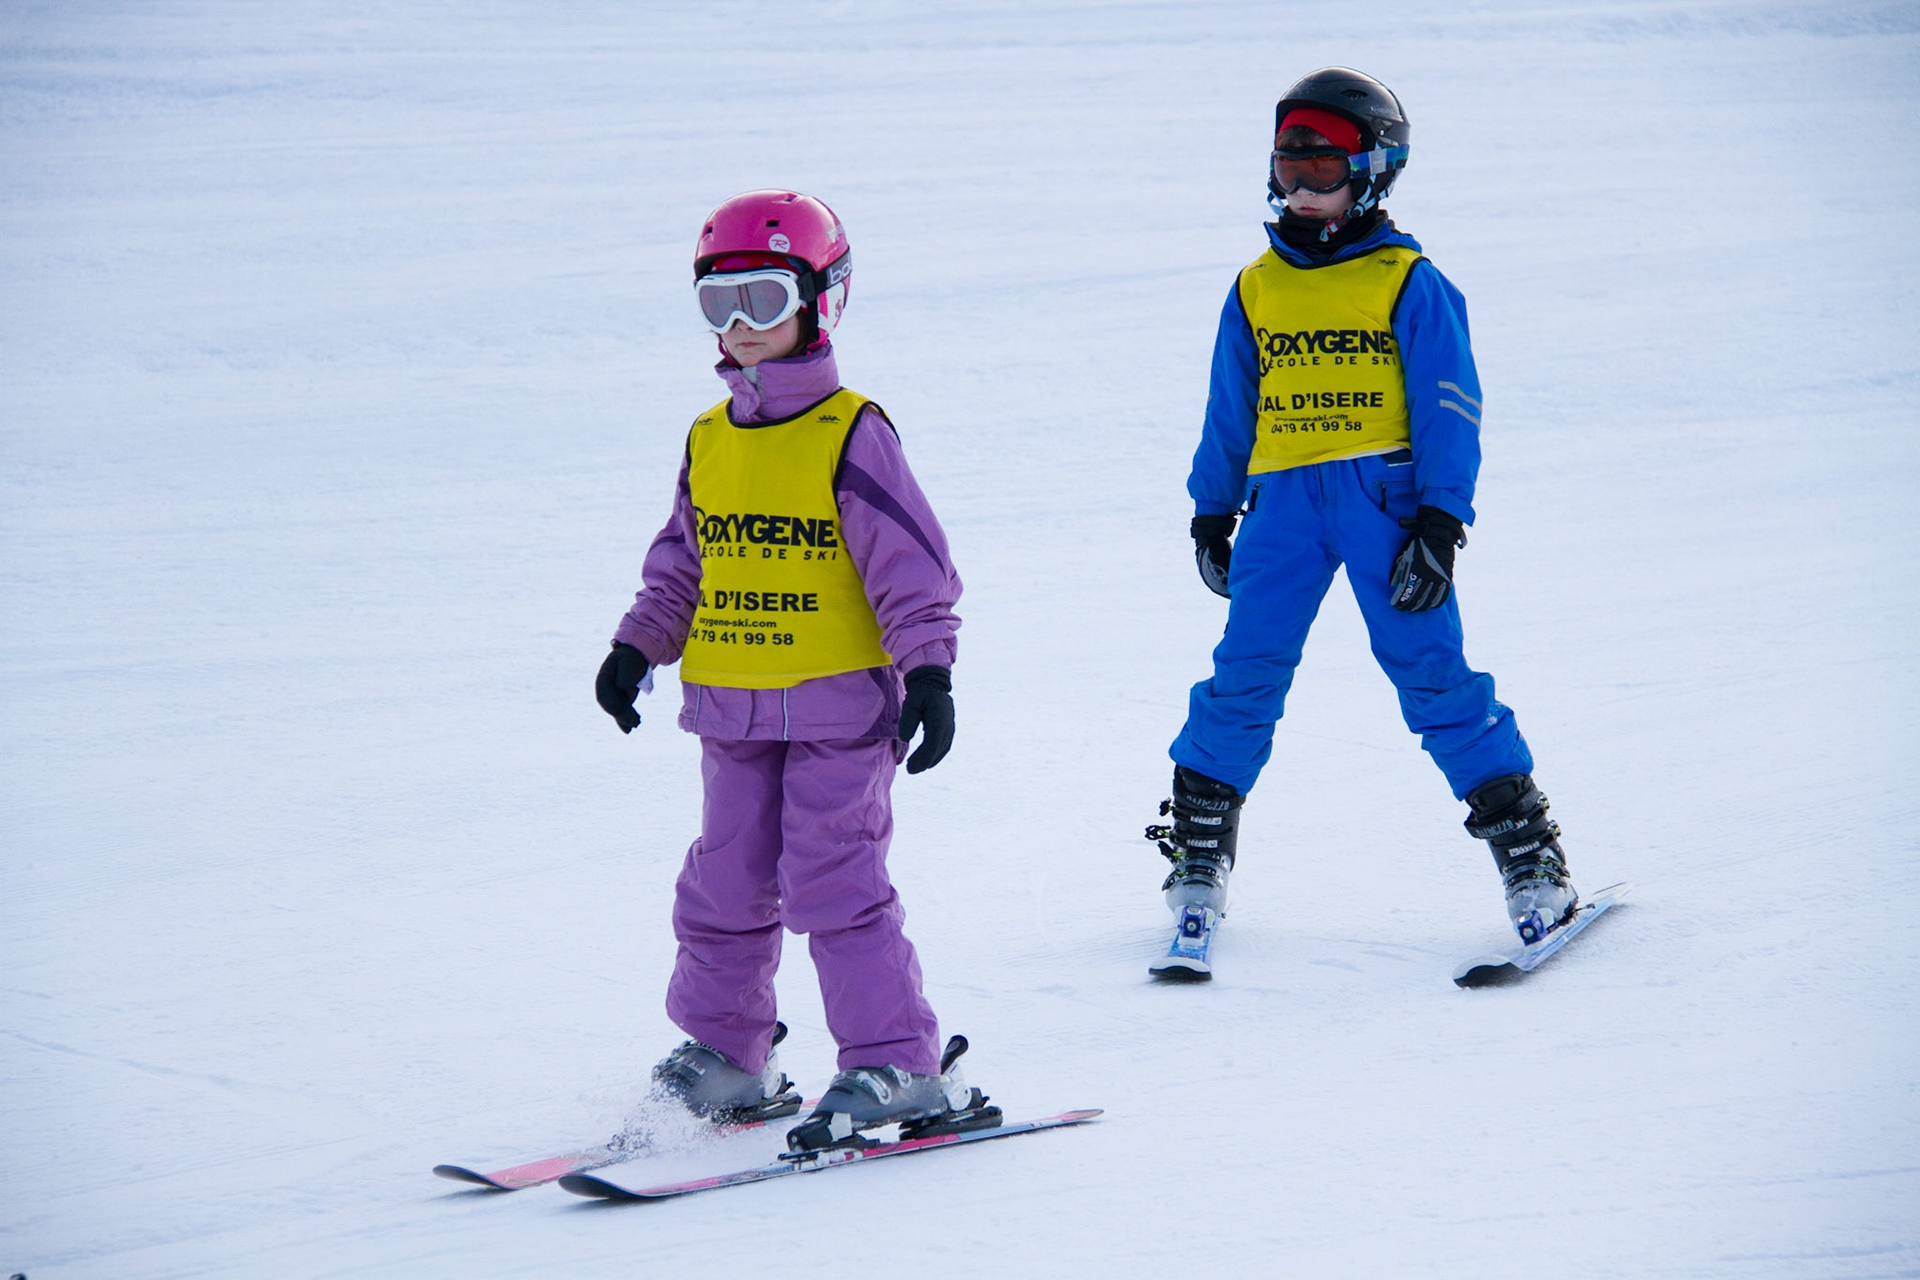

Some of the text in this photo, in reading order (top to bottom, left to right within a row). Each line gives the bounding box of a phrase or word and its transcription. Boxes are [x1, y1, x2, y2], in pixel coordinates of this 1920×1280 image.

[1268, 330, 1394, 357] OXYGENE
[1335, 356, 1357, 365] DE
[1372, 356, 1396, 366] SKI
[1292, 392, 1384, 410] D'ISERE
[1300, 422, 1316, 432] 41
[1321, 421, 1340, 432] 99
[1344, 421, 1362, 431] 58
[701, 513, 838, 548] OXYGENE
[762, 547, 787, 559] DE
[803, 550, 837, 560] SKI
[714, 590, 819, 612] D'ISERE
[701, 629, 716, 642] 79
[720, 631, 737, 644] 41
[744, 632, 766, 645] 99
[772, 633, 794, 645] 58
